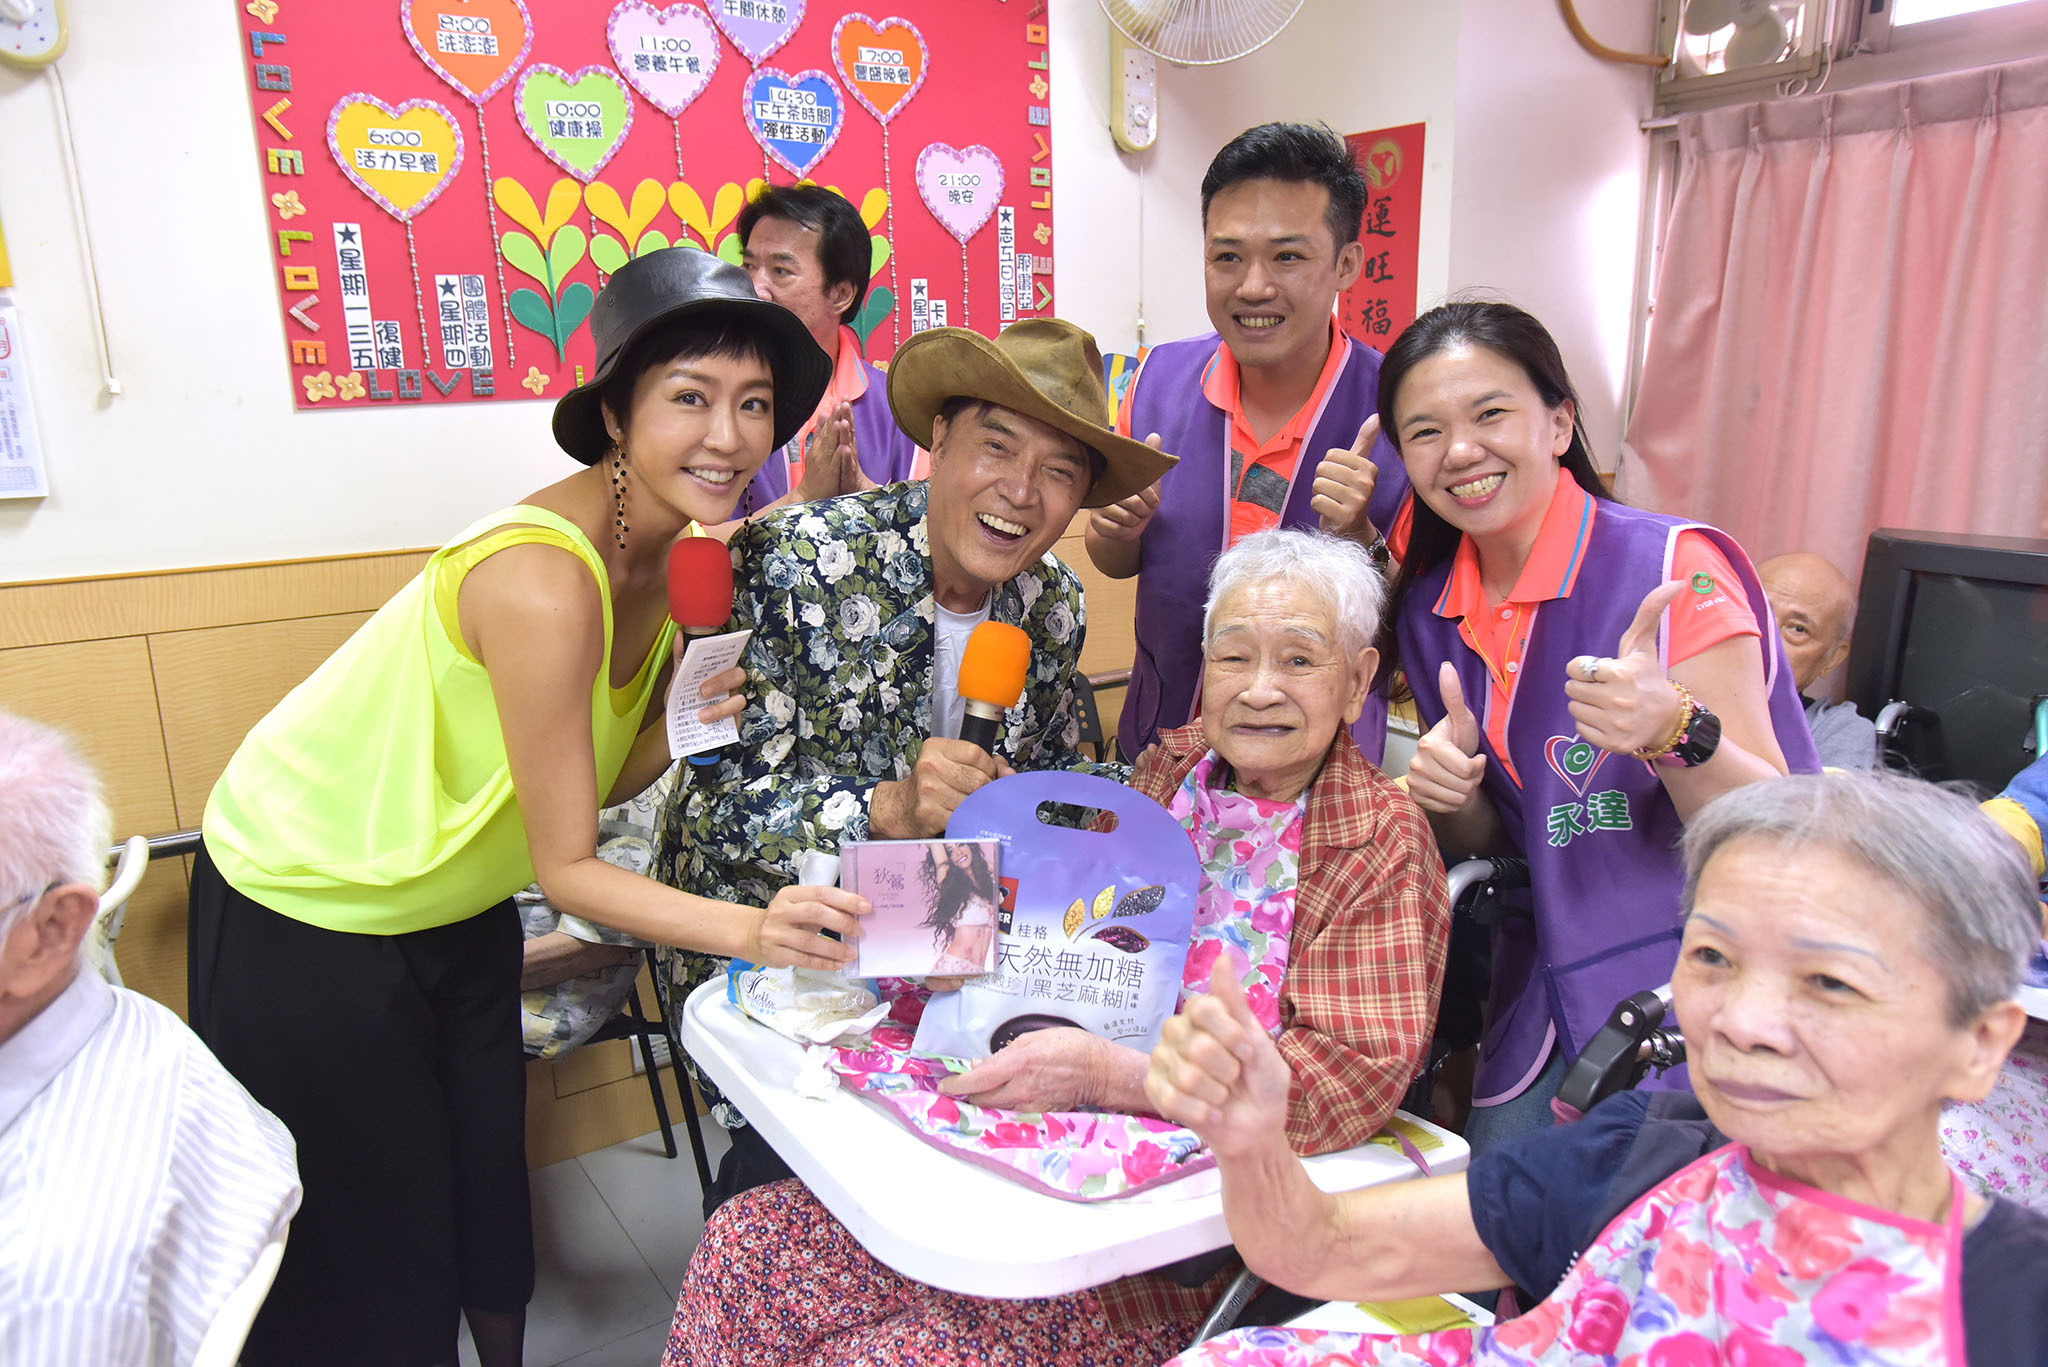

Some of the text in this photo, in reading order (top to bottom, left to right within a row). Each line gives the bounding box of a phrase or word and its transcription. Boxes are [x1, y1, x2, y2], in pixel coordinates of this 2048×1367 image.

[724, 0, 787, 23] 午間休憩
[439, 15, 490, 33] 8:00
[438, 32, 498, 55] 洗澎澎
[639, 36, 692, 53] 11:00
[634, 54, 701, 74] 營養午餐
[859, 49, 903, 64] 17:00
[854, 64, 911, 84] 豐盛晚餐
[251, 31, 304, 175] LOVE
[769, 88, 817, 106] 14:30
[545, 102, 601, 118] 10:00
[756, 103, 832, 125] 下午茶時間
[369, 129, 421, 147] 6:00
[547, 119, 604, 139] 健康操
[763, 121, 826, 144] 彈性活動
[356, 149, 438, 173] 活力早餐
[1028, 106, 1052, 211] LOVE
[938, 174, 982, 187] 21:00
[948, 189, 975, 205] 晚安
[1361, 195, 1397, 350] 運旺福
[278, 229, 328, 365] LOVE
[338, 247, 377, 369] 星期一三五
[461, 275, 493, 367] 團體活動
[439, 299, 468, 368] 星期四
[375, 321, 403, 370] 復健
[368, 367, 495, 399] LOVE
[1546, 789, 1633, 847] 永達
[1017, 922, 1048, 941] 桂格
[998, 941, 1147, 990] 天然無加糖
[1030, 978, 1125, 1010] 黑芝麻糊
